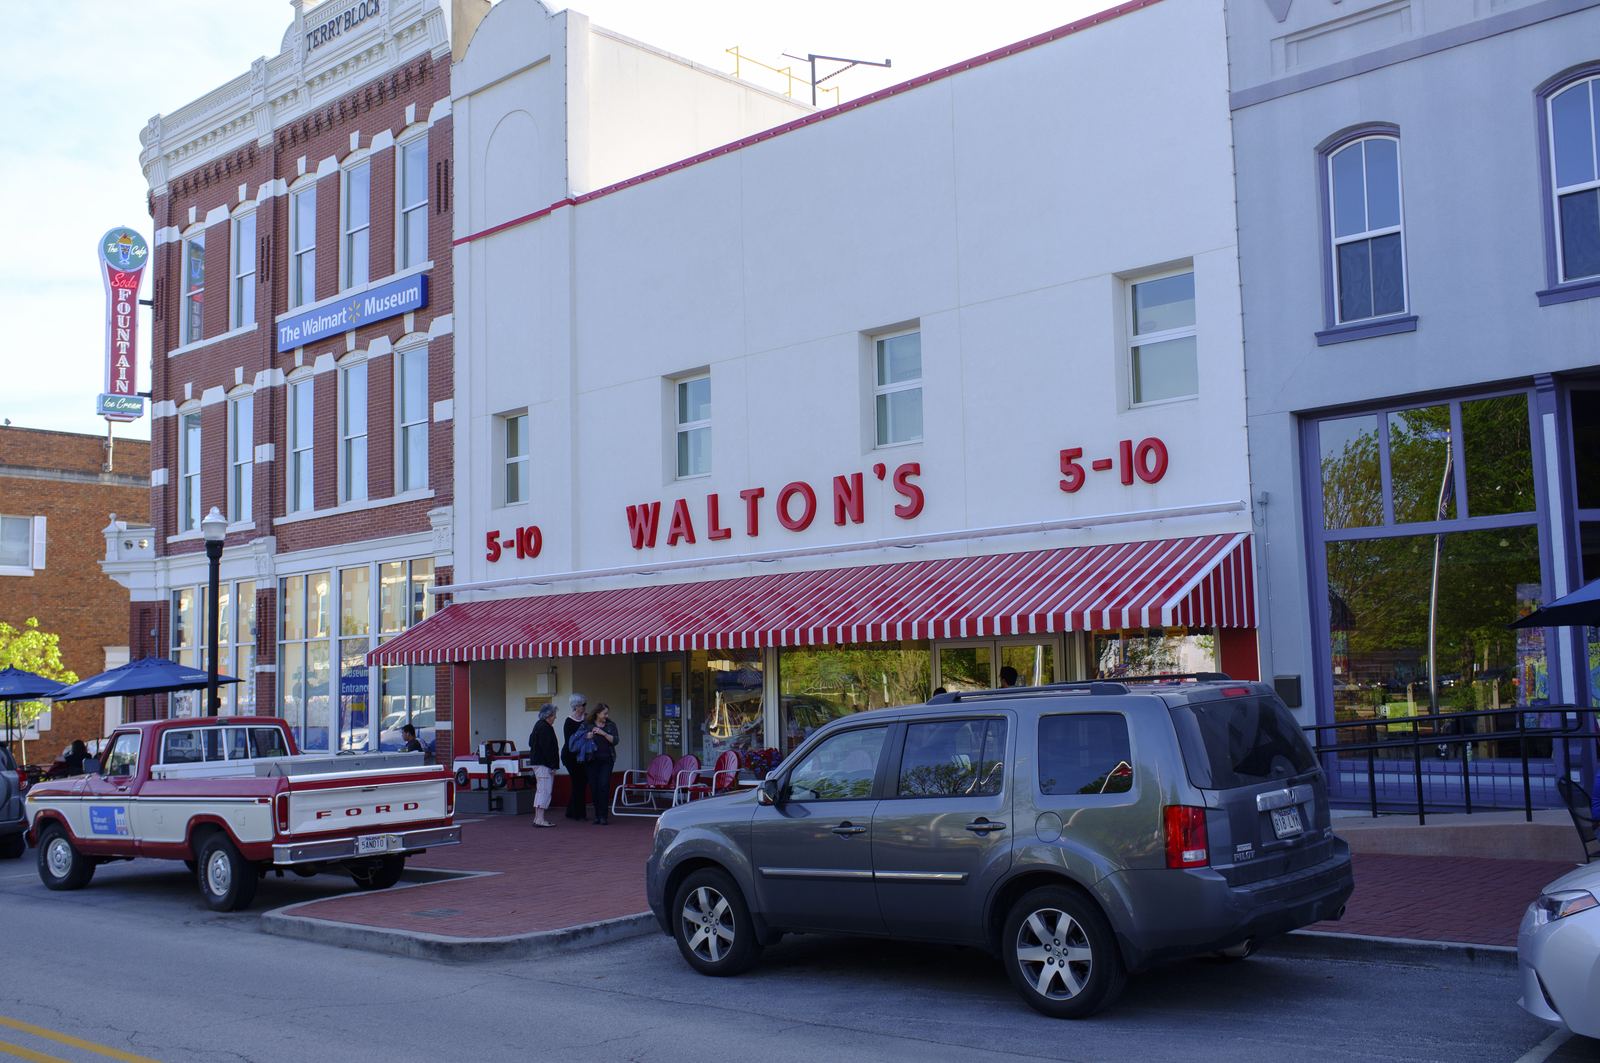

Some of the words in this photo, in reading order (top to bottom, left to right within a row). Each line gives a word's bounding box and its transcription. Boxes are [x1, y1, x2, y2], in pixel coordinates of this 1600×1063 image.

[306, 14, 343, 52] TERRY
[344, 0, 380, 31] BLOCK
[107, 243, 119, 253] The
[111, 272, 138, 289] Soda
[280, 325, 300, 345] The
[302, 307, 347, 337] Walmart
[364, 287, 419, 317] Museum
[115, 288, 132, 393] FOUNTAIN
[104, 397, 116, 408] Ice
[116, 398, 142, 410] Cream
[1059, 437, 1169, 493] 5-10
[625, 461, 926, 550] WALTON'S
[486, 525, 543, 563] 5-10
[341, 682, 369, 694] Entranc
[316, 802, 419, 820] FORD
